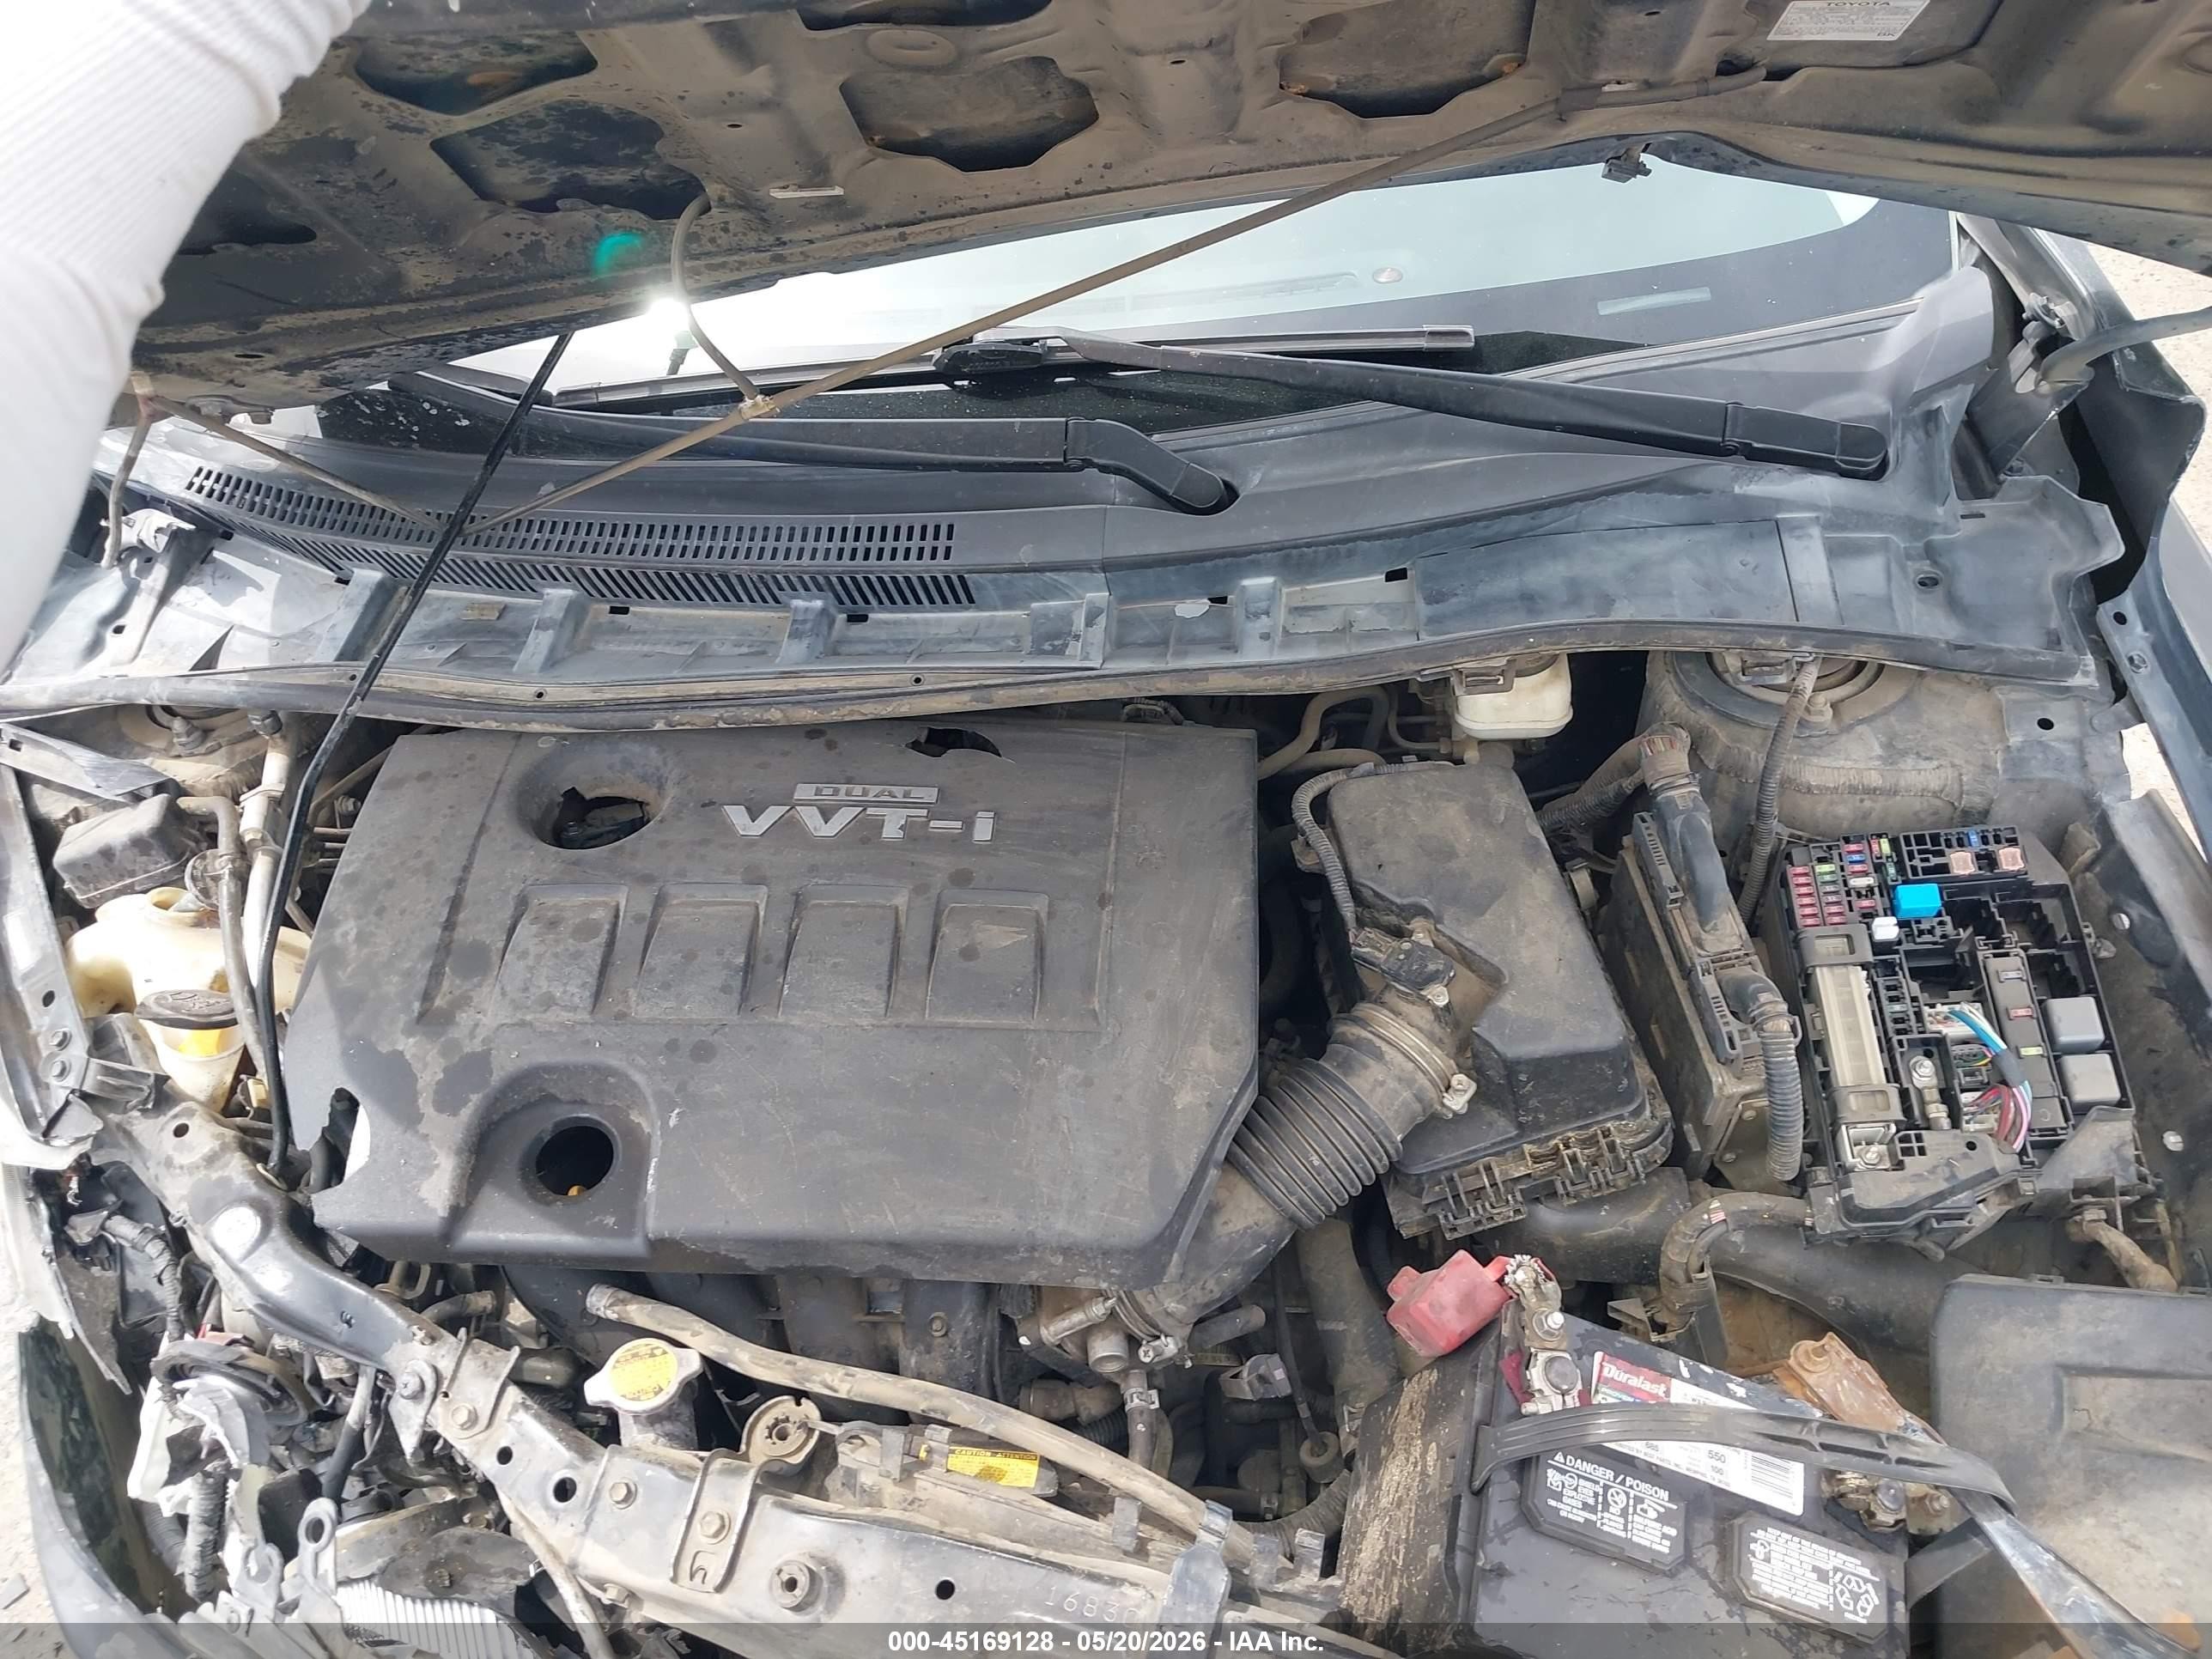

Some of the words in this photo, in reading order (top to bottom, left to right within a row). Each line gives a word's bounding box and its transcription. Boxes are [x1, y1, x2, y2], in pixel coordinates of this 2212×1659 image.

[815, 785, 925, 799] DUAL
[1602, 1362, 1669, 1400] Duralast
[955, 1449, 991, 1457] CAUTION
[1707, 1449, 1726, 1463] 550
[1565, 1455, 1614, 1481] DANGER
[1615, 1474, 1625, 1484] /
[1626, 1476, 1669, 1501] POISON
